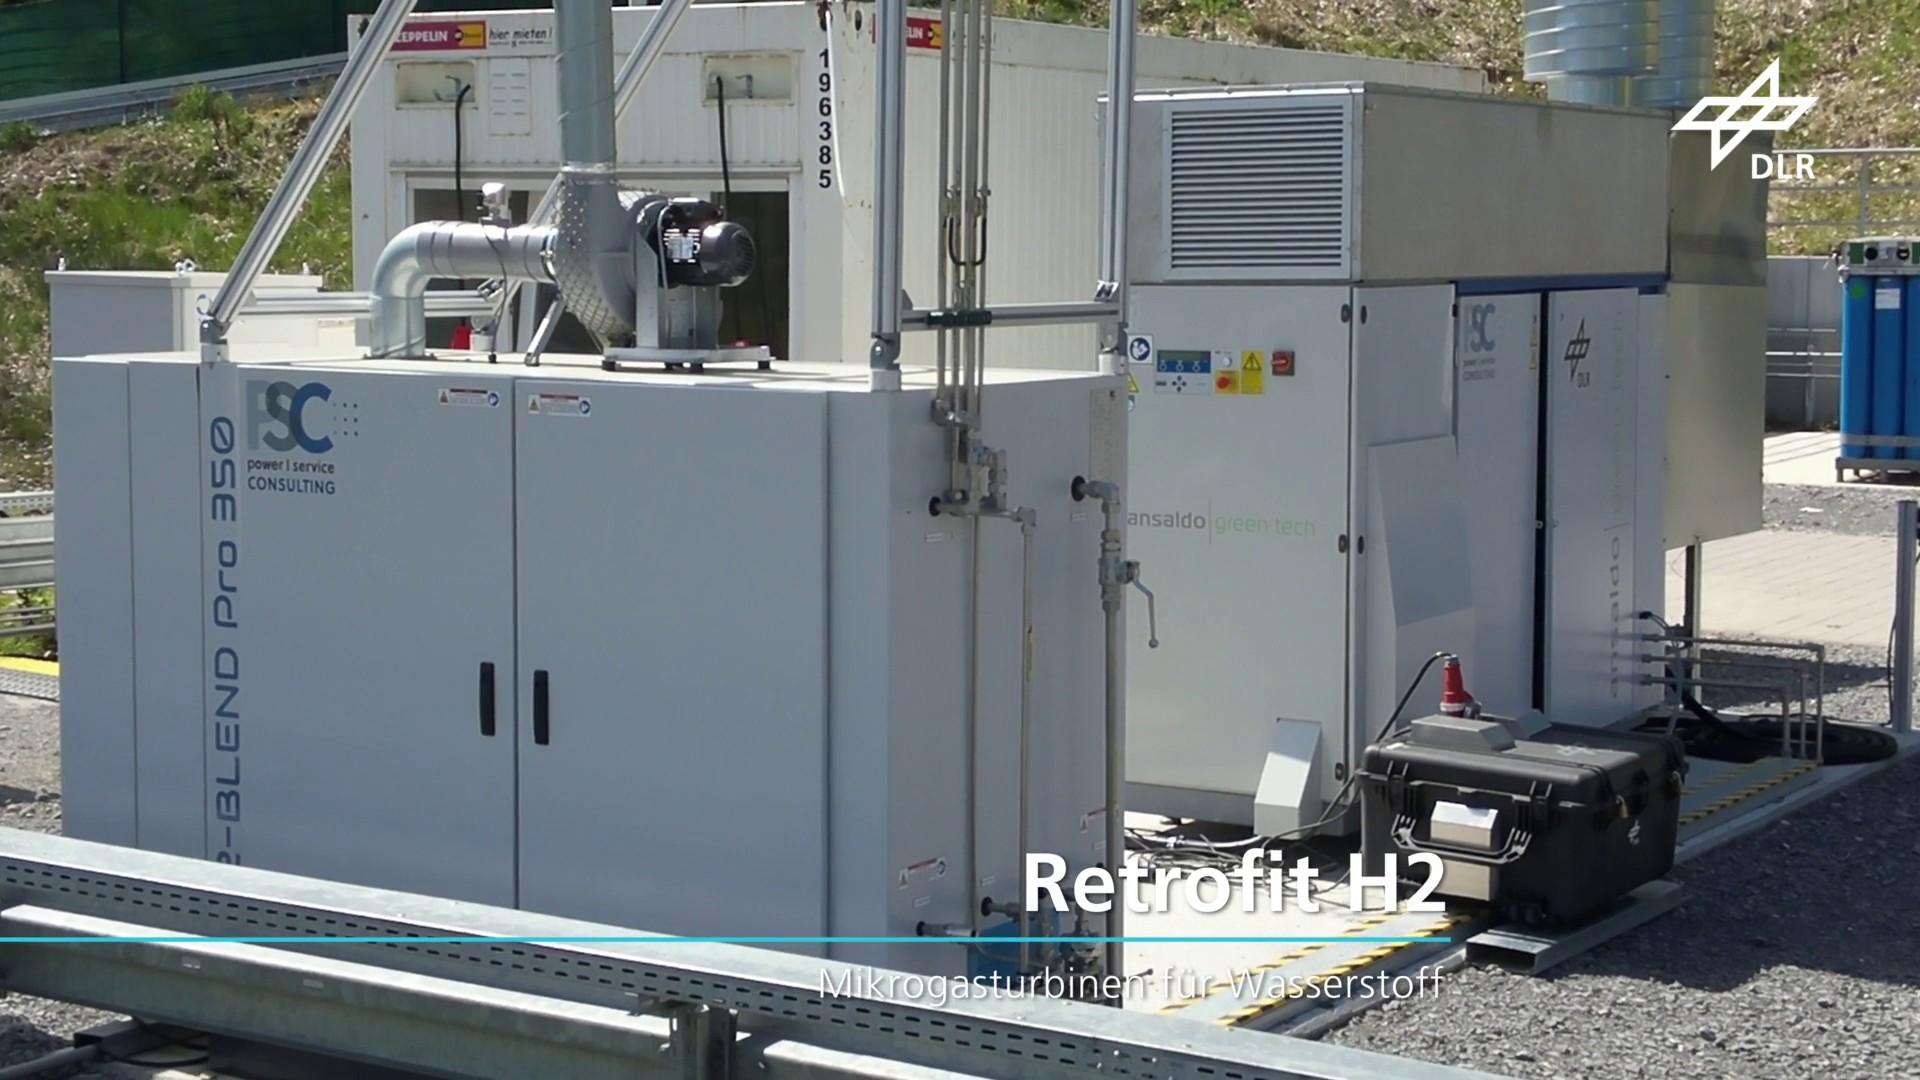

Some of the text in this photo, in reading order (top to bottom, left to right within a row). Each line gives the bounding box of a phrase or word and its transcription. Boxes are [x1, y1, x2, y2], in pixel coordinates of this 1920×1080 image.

[489, 28, 510, 40] hier
[818, 48, 832, 189] 196385
[246, 380, 334, 454] PSC
[210, 415, 236, 523] 350
[247, 459, 335, 474] power service
[247, 475, 336, 495] CONSULTING
[1127, 511, 1316, 537] ansaldo green tech
[213, 540, 239, 629] Pro
